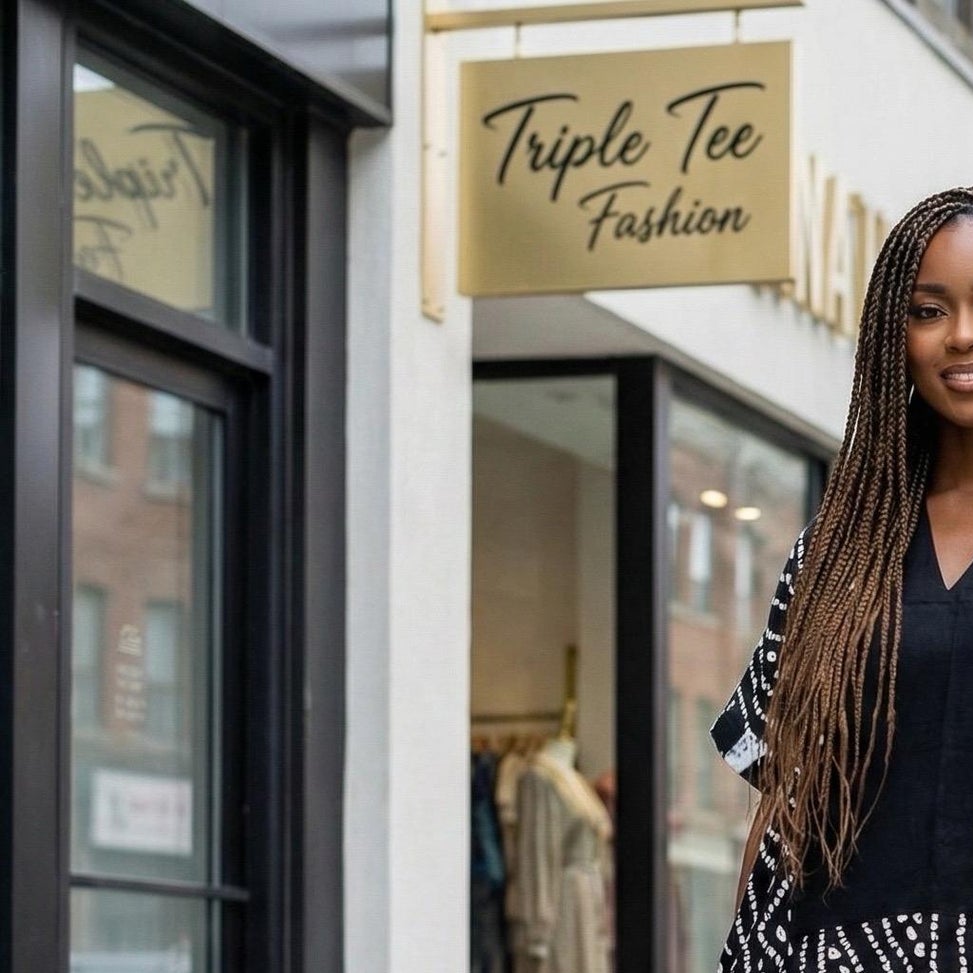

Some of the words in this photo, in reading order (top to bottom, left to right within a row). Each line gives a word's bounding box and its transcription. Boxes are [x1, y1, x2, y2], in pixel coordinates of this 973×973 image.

[482, 93, 651, 202] Triple
[666, 81, 766, 174] Tee
[578, 180, 751, 251] Fashion
